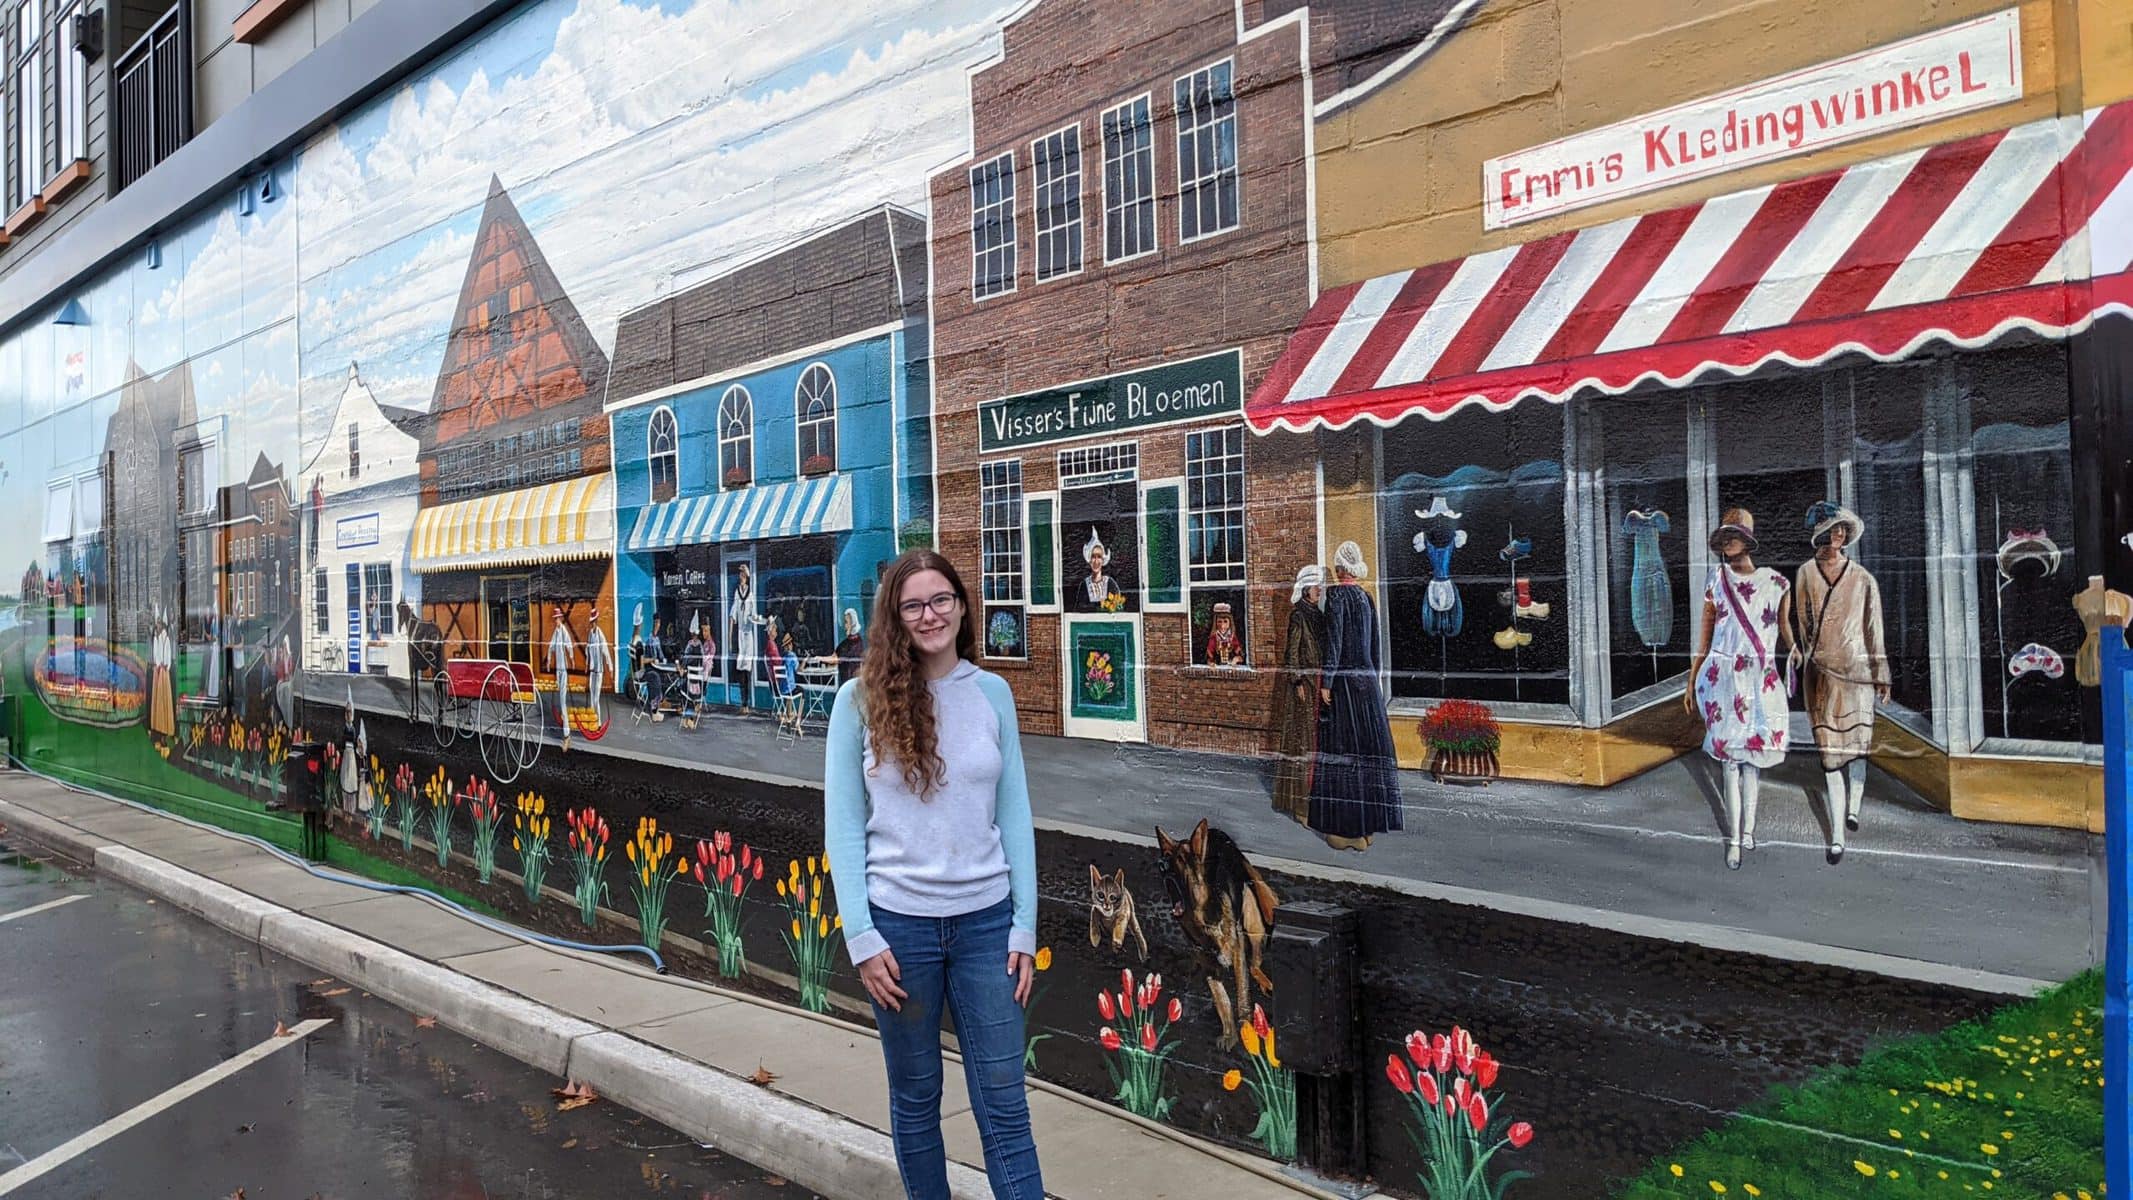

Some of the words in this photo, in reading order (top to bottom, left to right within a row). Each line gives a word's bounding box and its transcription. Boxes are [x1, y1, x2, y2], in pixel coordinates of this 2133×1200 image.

[1501, 152, 1624, 209] Emmi's
[991, 405, 1065, 441] Visser's
[1068, 393, 1116, 429] Fijne
[685, 568, 706, 585] Coffee
